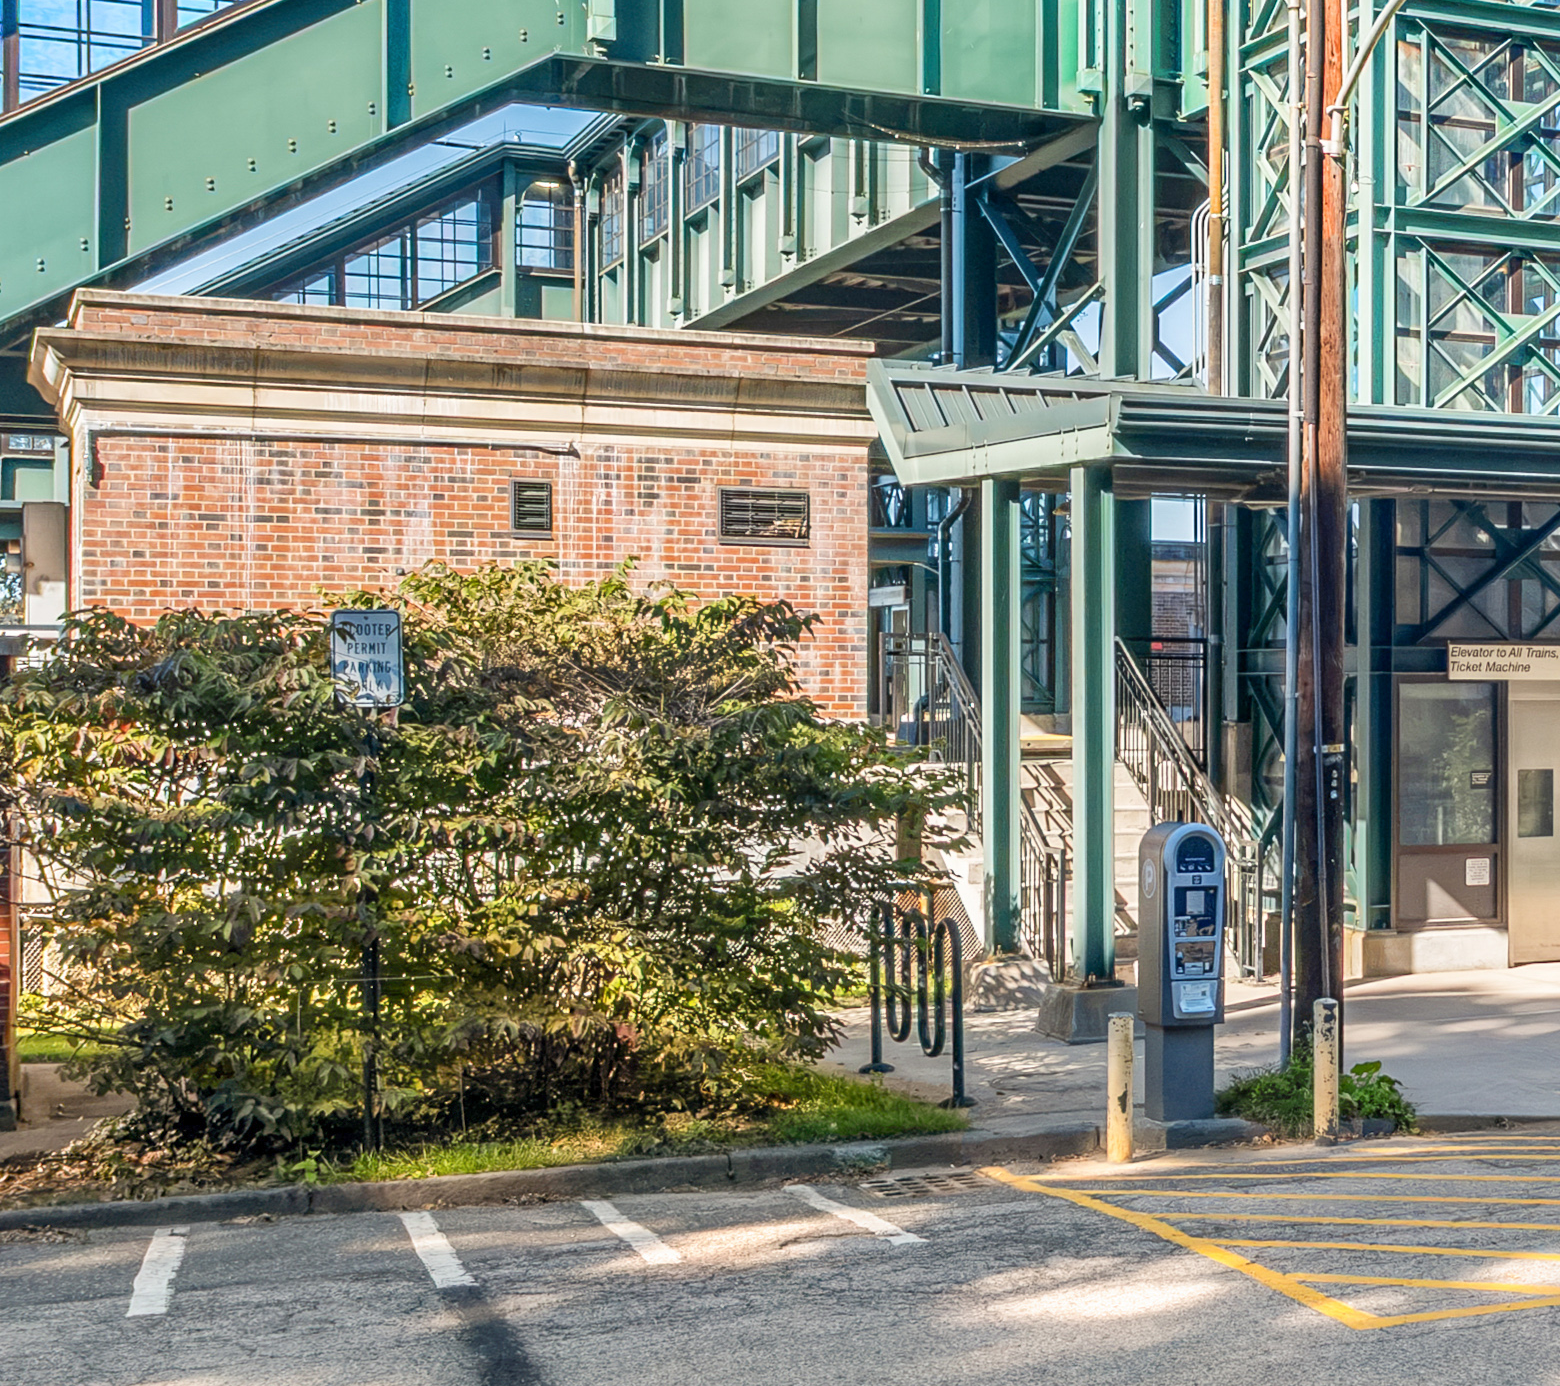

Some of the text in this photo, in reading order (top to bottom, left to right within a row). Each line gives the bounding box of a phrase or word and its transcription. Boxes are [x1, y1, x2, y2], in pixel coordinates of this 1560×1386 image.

[342, 623, 392, 636] COOTER
[347, 642, 387, 654] PERMIT
[1450, 646, 1559, 659] Elevator to All Trains,
[343, 661, 391, 674] PARKING
[1450, 661, 1531, 673] Ticket Machine
